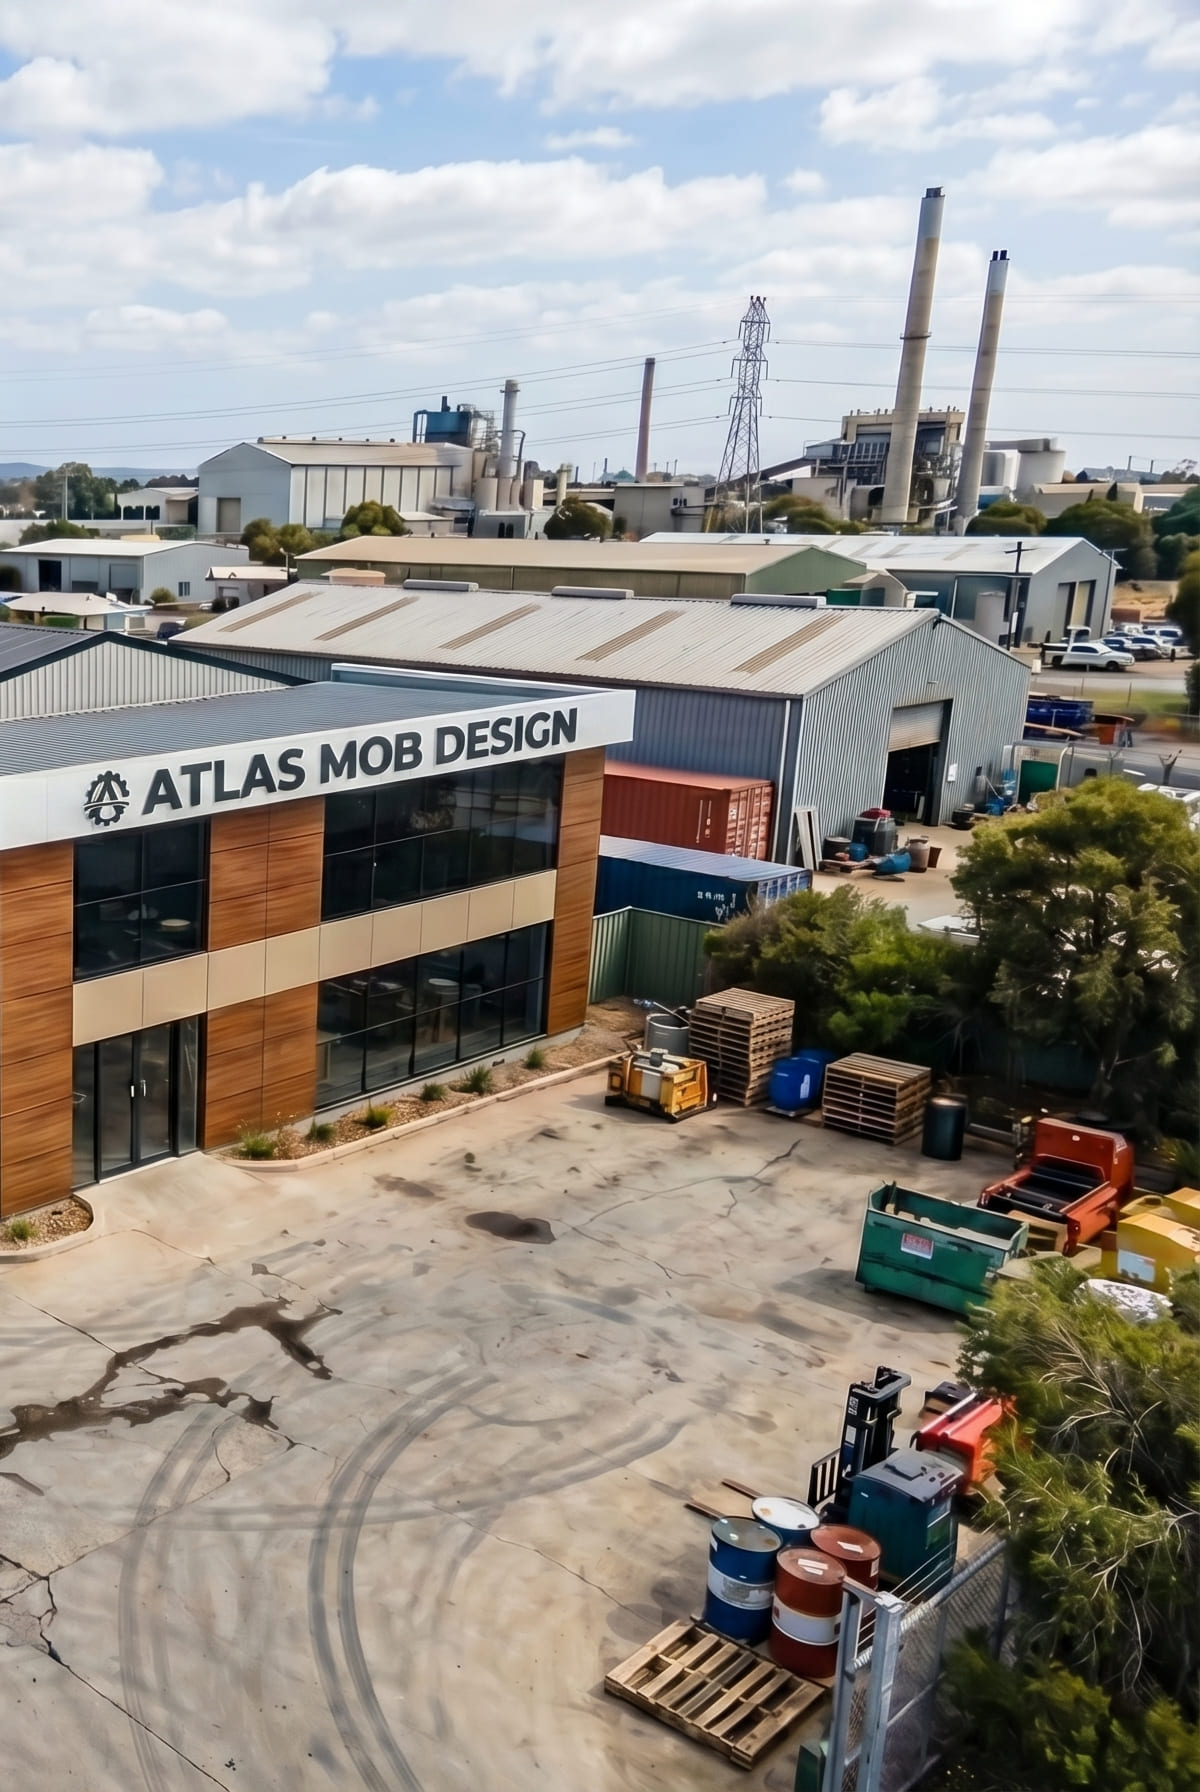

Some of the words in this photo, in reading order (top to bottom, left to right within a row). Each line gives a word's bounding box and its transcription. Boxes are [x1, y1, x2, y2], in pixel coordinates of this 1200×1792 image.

[141, 748, 306, 816] ATLAS
[319, 731, 423, 785] MOB
[435, 707, 578, 766] DESIGN
